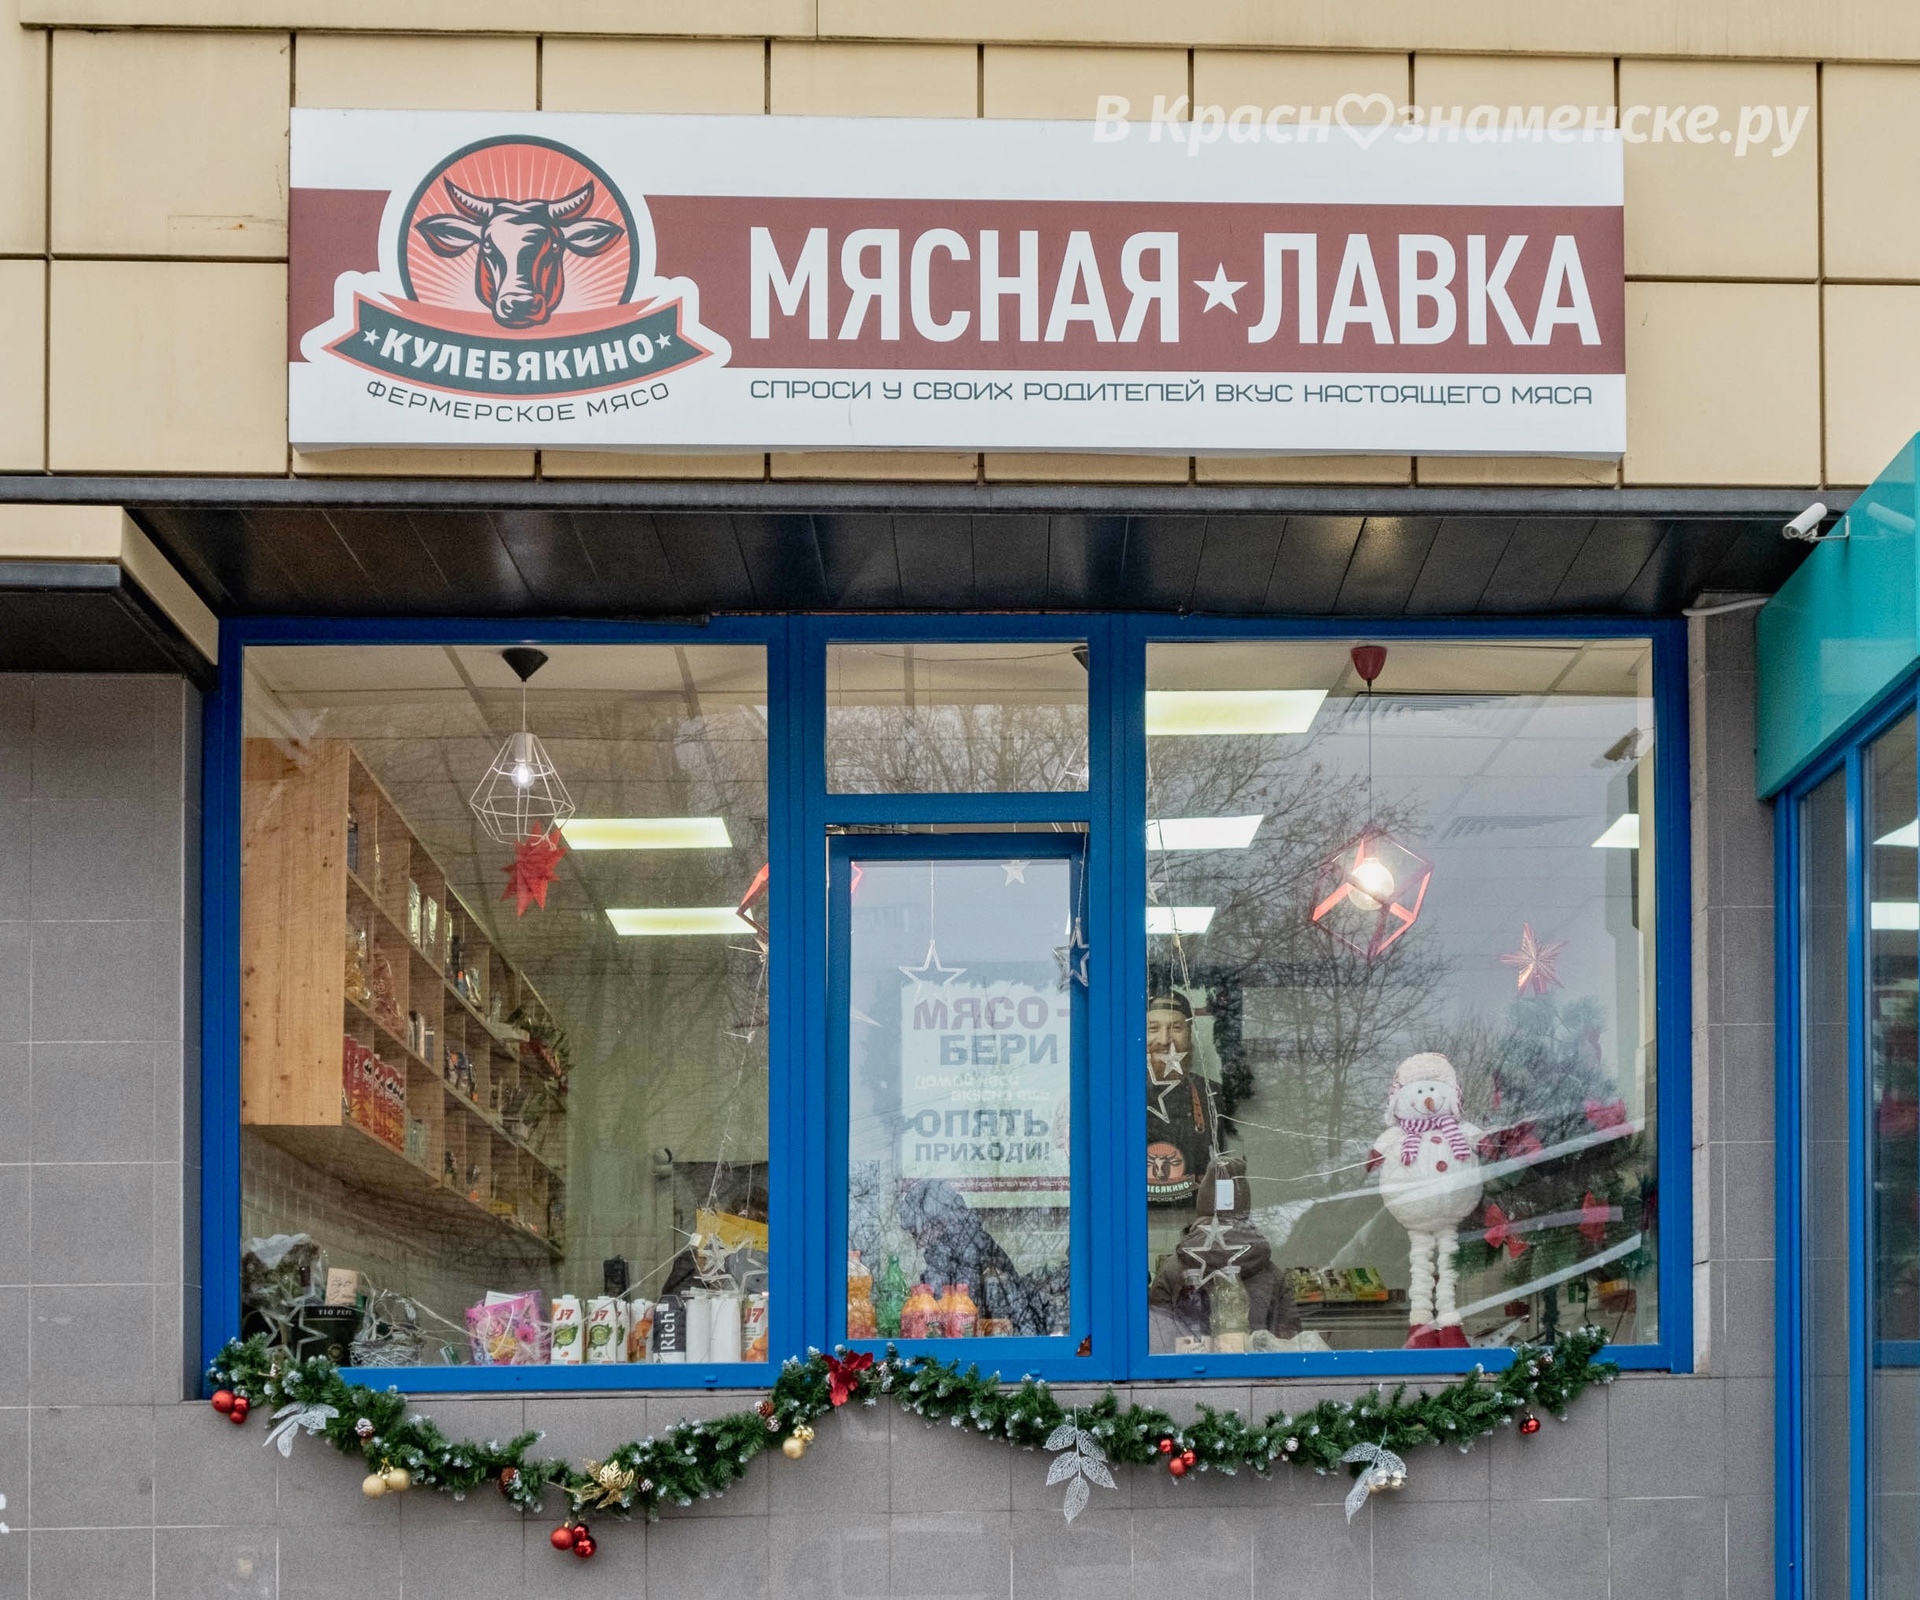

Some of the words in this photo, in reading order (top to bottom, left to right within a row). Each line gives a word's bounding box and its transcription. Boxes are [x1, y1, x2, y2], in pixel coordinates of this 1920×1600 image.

[749, 226, 1179, 343] МЯСНАЯ
[1247, 233, 1602, 345] ЛАВКА
[379, 327, 654, 381] КУЛЕБЯКИНО
[366, 380, 576, 422] ФЕРМЕРСКОЕ
[586, 382, 669, 417] МЯСО
[749, 380, 872, 399] СПРОСИ
[883, 382, 903, 400] У
[912, 382, 1013, 401] СВОИХ
[1024, 379, 1204, 403] РОДИТЕЛЕЙ
[1215, 384, 1293, 403] ВКУС
[1304, 385, 1501, 405] НАСТОЯЩЕГО
[1512, 386, 1592, 404] МЯСА
[940, 1033, 1058, 1065] БЕРИ
[914, 1108, 1049, 1138] ОПЯТЬ
[915, 1141, 1050, 1163] ПРИХОДИ!
[660, 1312, 676, 1351] Rich
